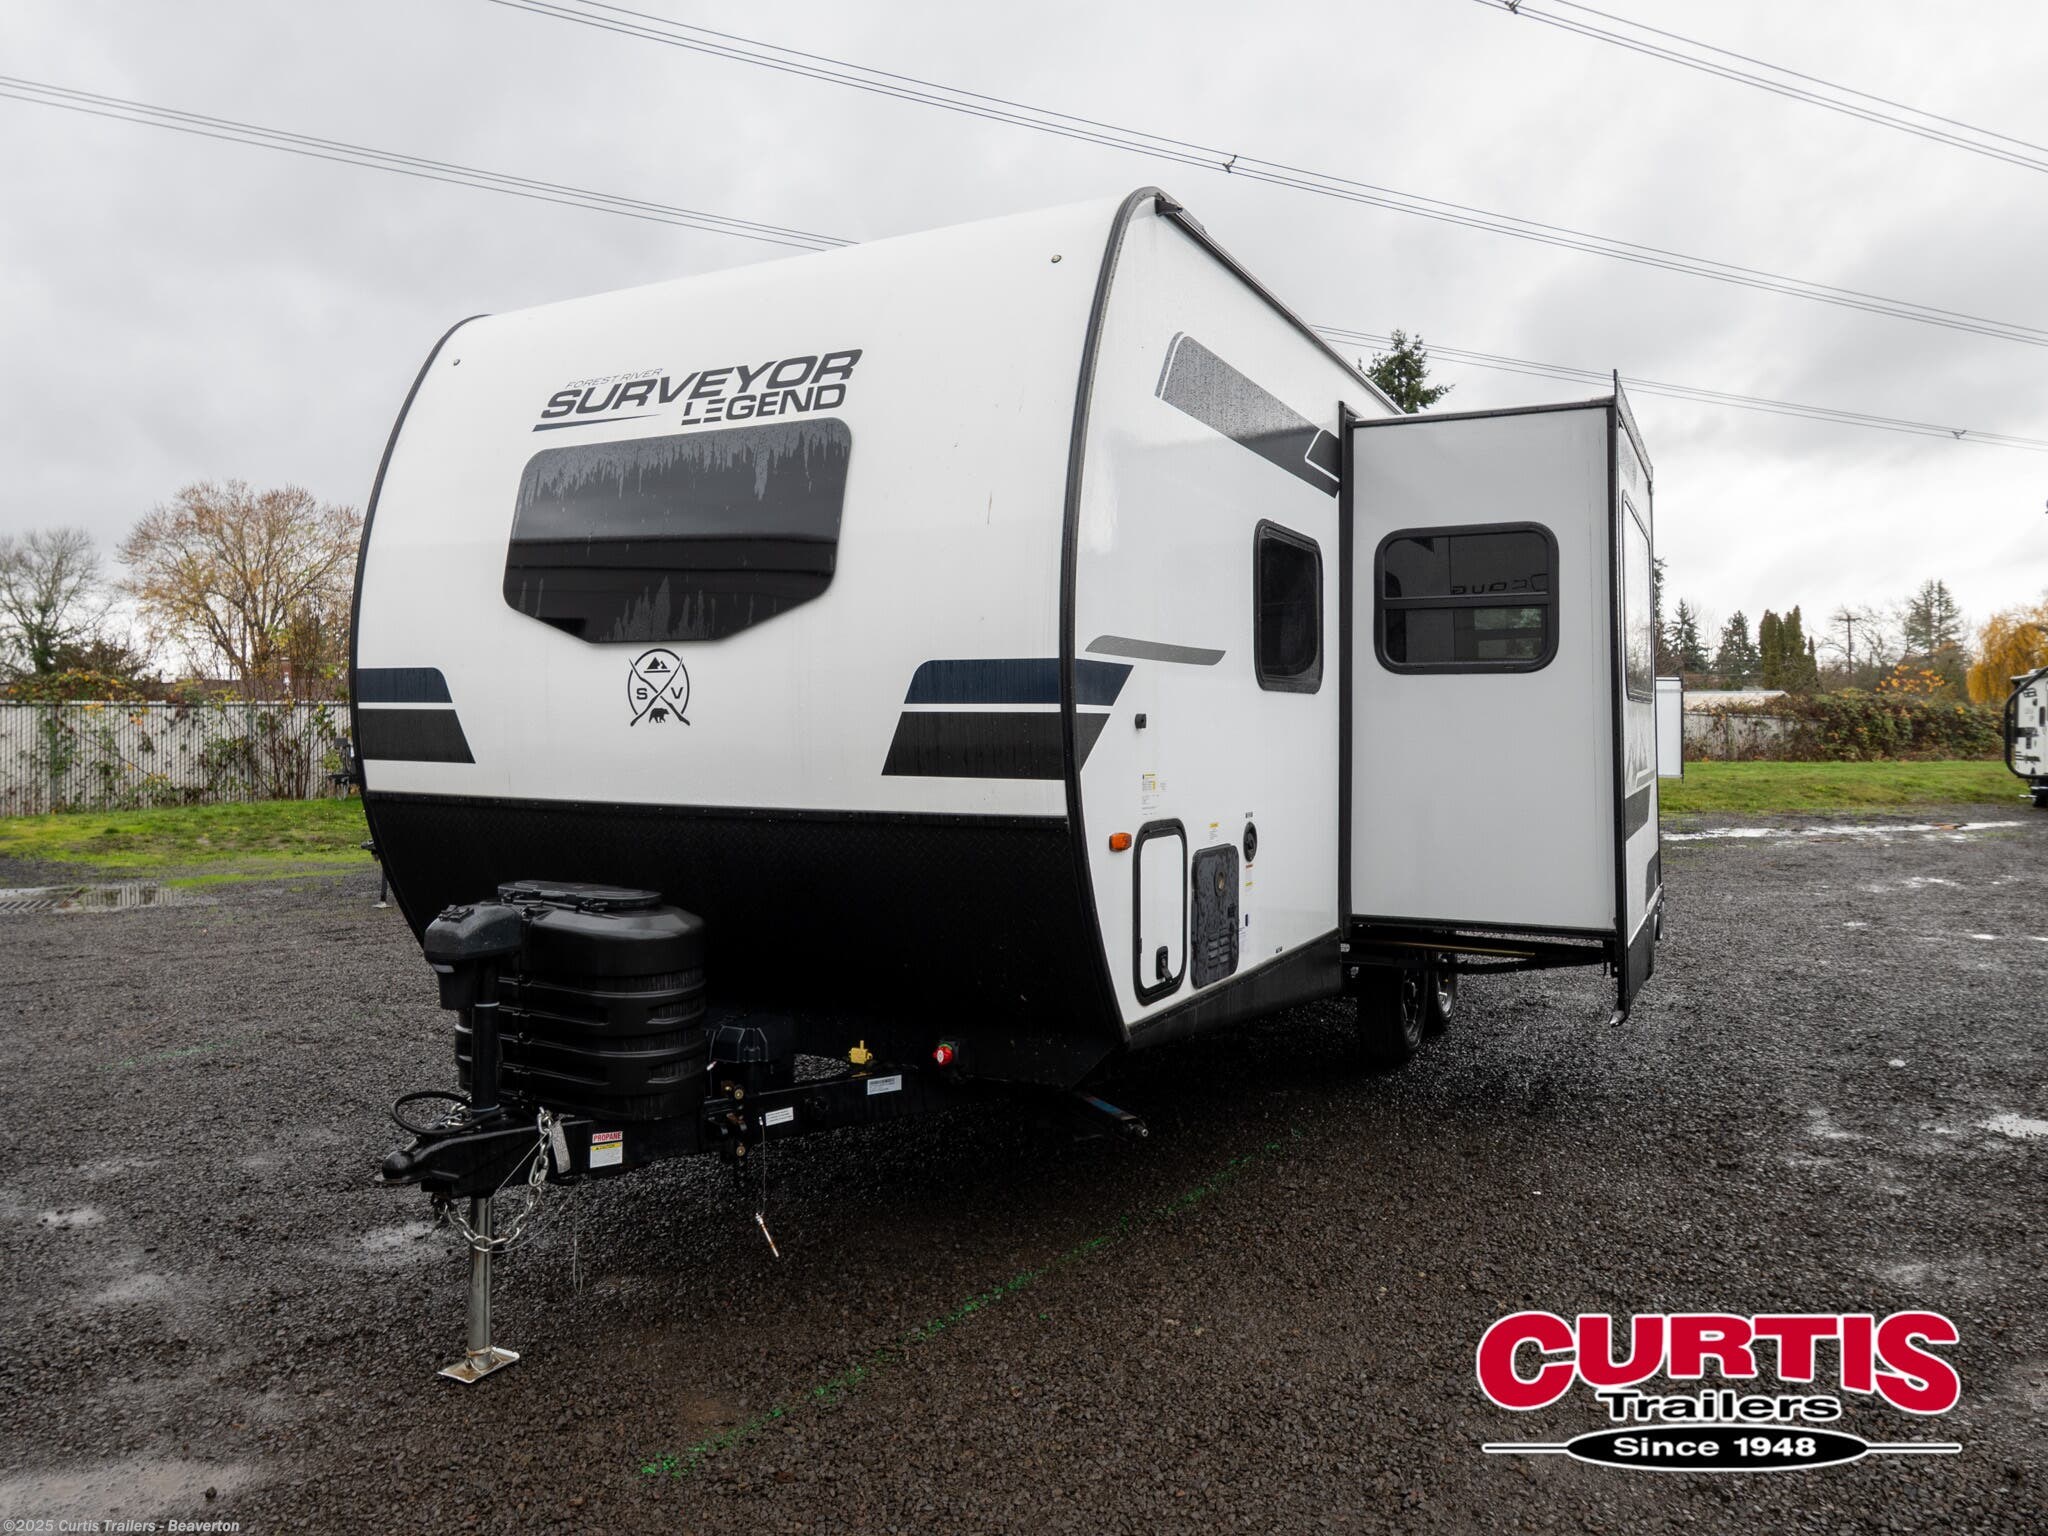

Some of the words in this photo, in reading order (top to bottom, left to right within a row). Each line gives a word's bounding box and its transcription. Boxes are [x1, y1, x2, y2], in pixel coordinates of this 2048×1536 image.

[540, 348, 863, 419] SURVEYOR
[565, 375, 619, 389] FOREST
[621, 367, 663, 381] RIVER
[681, 383, 846, 426] LEGEND
[593, 1131, 622, 1142] PROPANE
